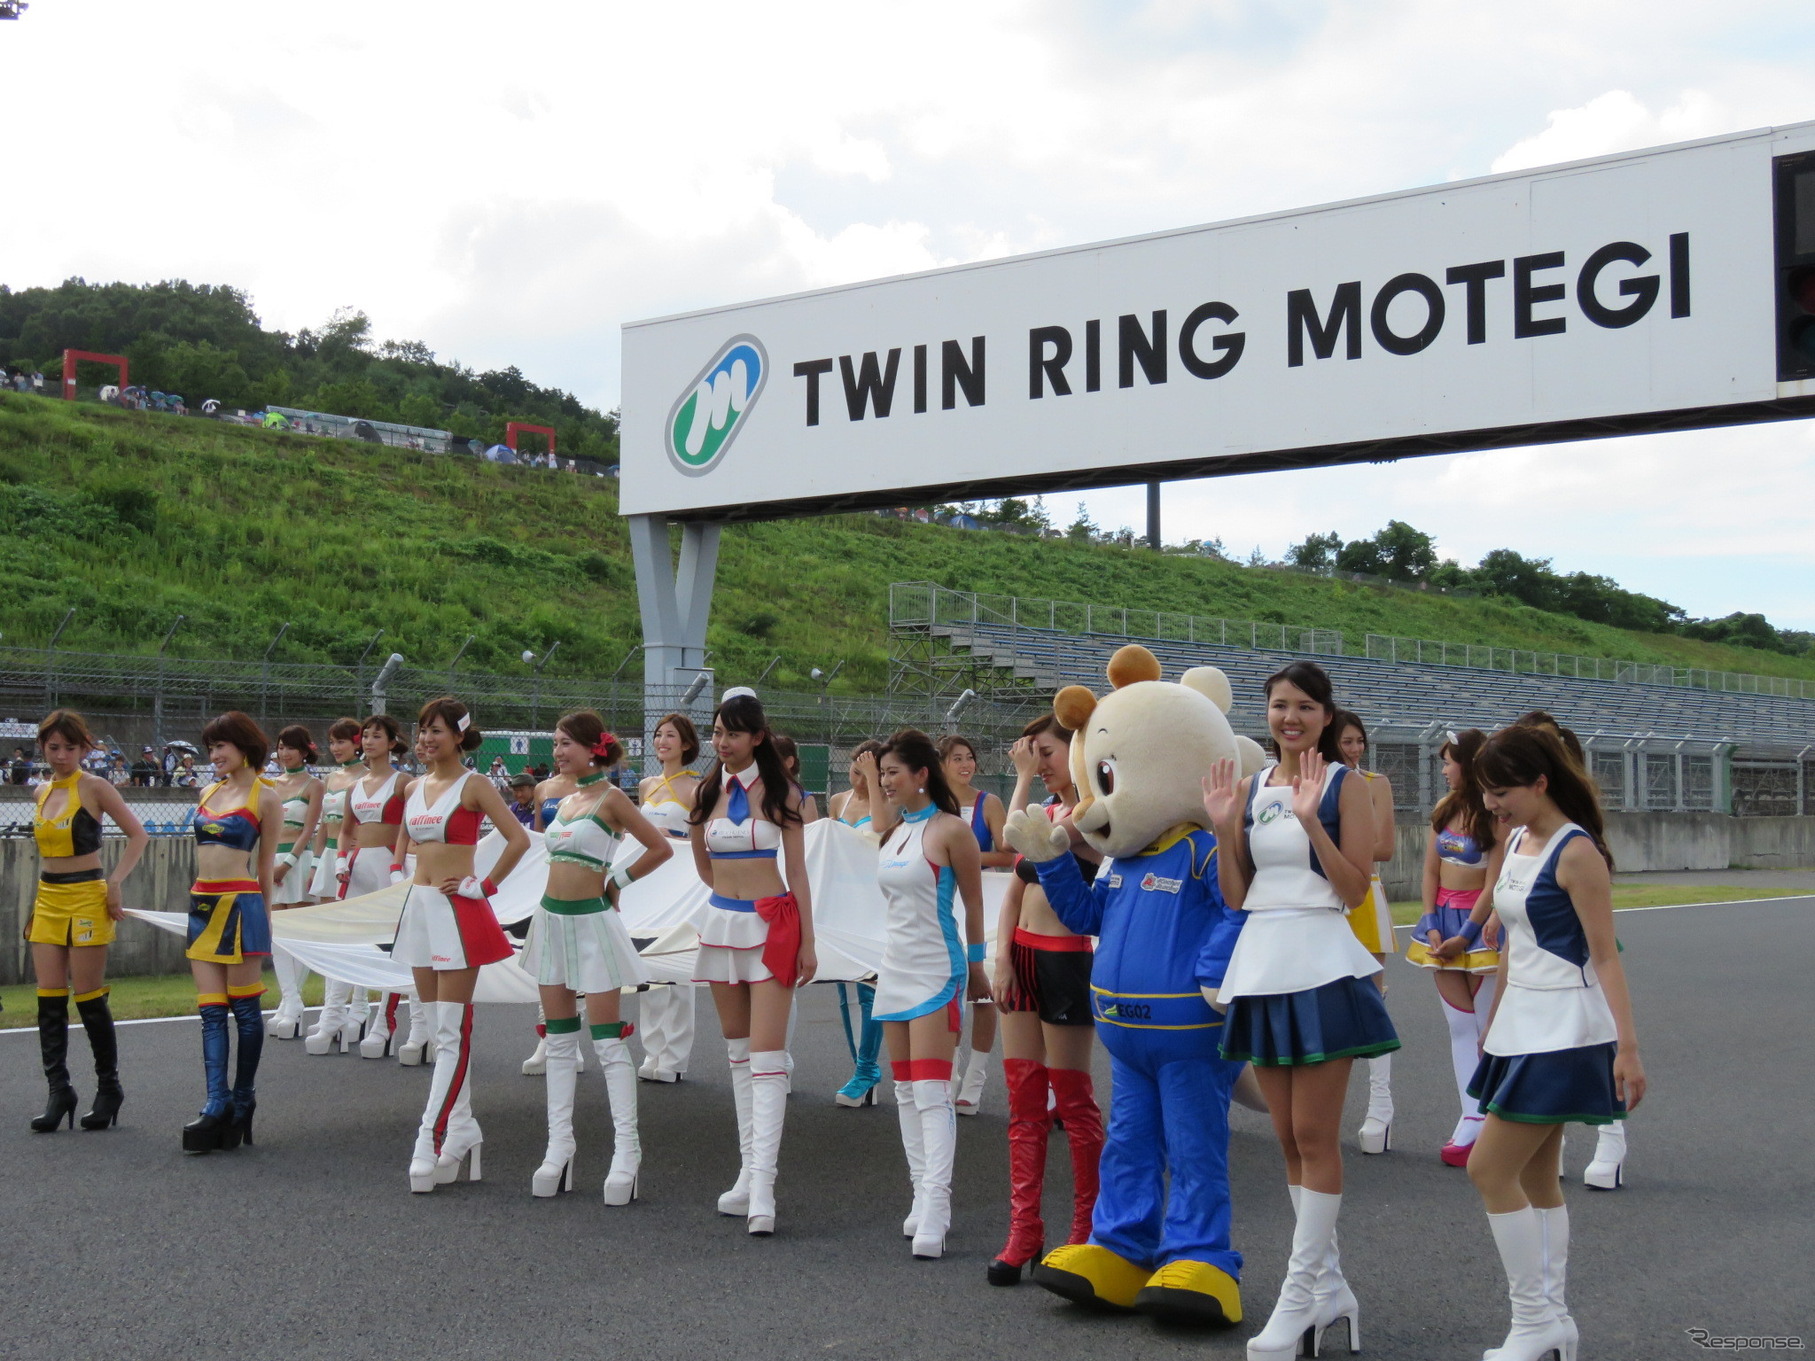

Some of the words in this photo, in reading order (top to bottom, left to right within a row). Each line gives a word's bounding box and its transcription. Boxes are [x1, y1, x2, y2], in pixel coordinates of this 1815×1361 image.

[793, 336, 986, 427] TWIN
[1029, 302, 1247, 400] RING
[1287, 231, 1691, 368] MOTEGI
